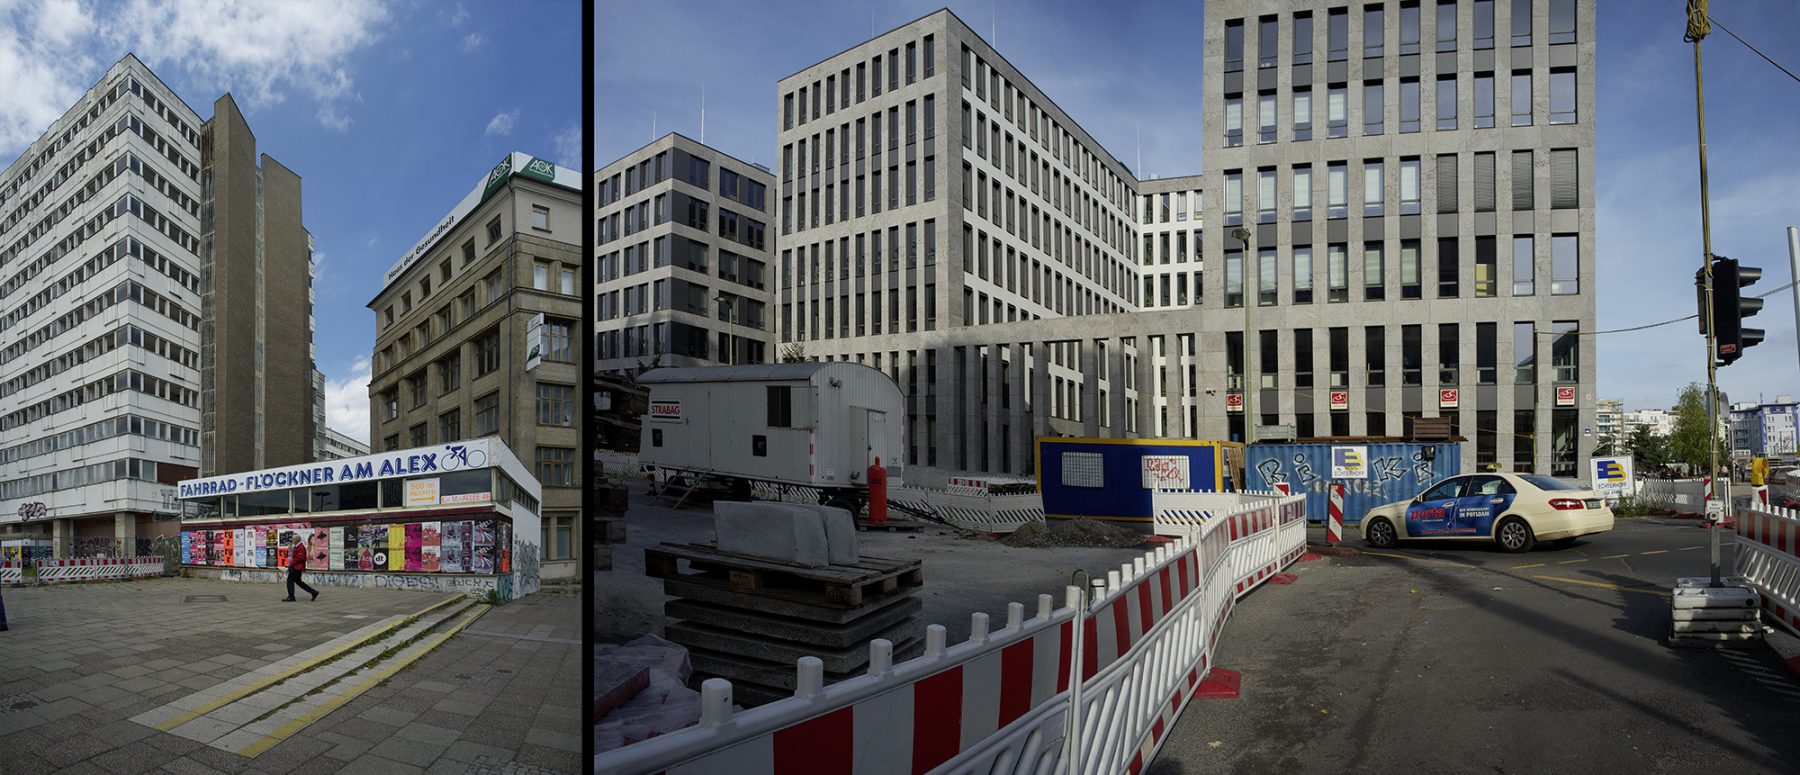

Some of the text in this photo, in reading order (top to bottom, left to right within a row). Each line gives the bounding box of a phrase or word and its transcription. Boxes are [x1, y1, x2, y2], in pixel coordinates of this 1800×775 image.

[490, 156, 510, 182] AOK
[529, 160, 554, 175] AOK
[388, 215, 455, 280] Haus der Gesundheit
[651, 404, 680, 415] STRABAG
[180, 478, 237, 498] FAHRRAD
[246, 465, 335, 492] FLÖCKNER
[339, 460, 374, 482] AM
[377, 452, 438, 478] ALEX
[410, 482, 425, 490] 500
[1410, 506, 1446, 521] porta
